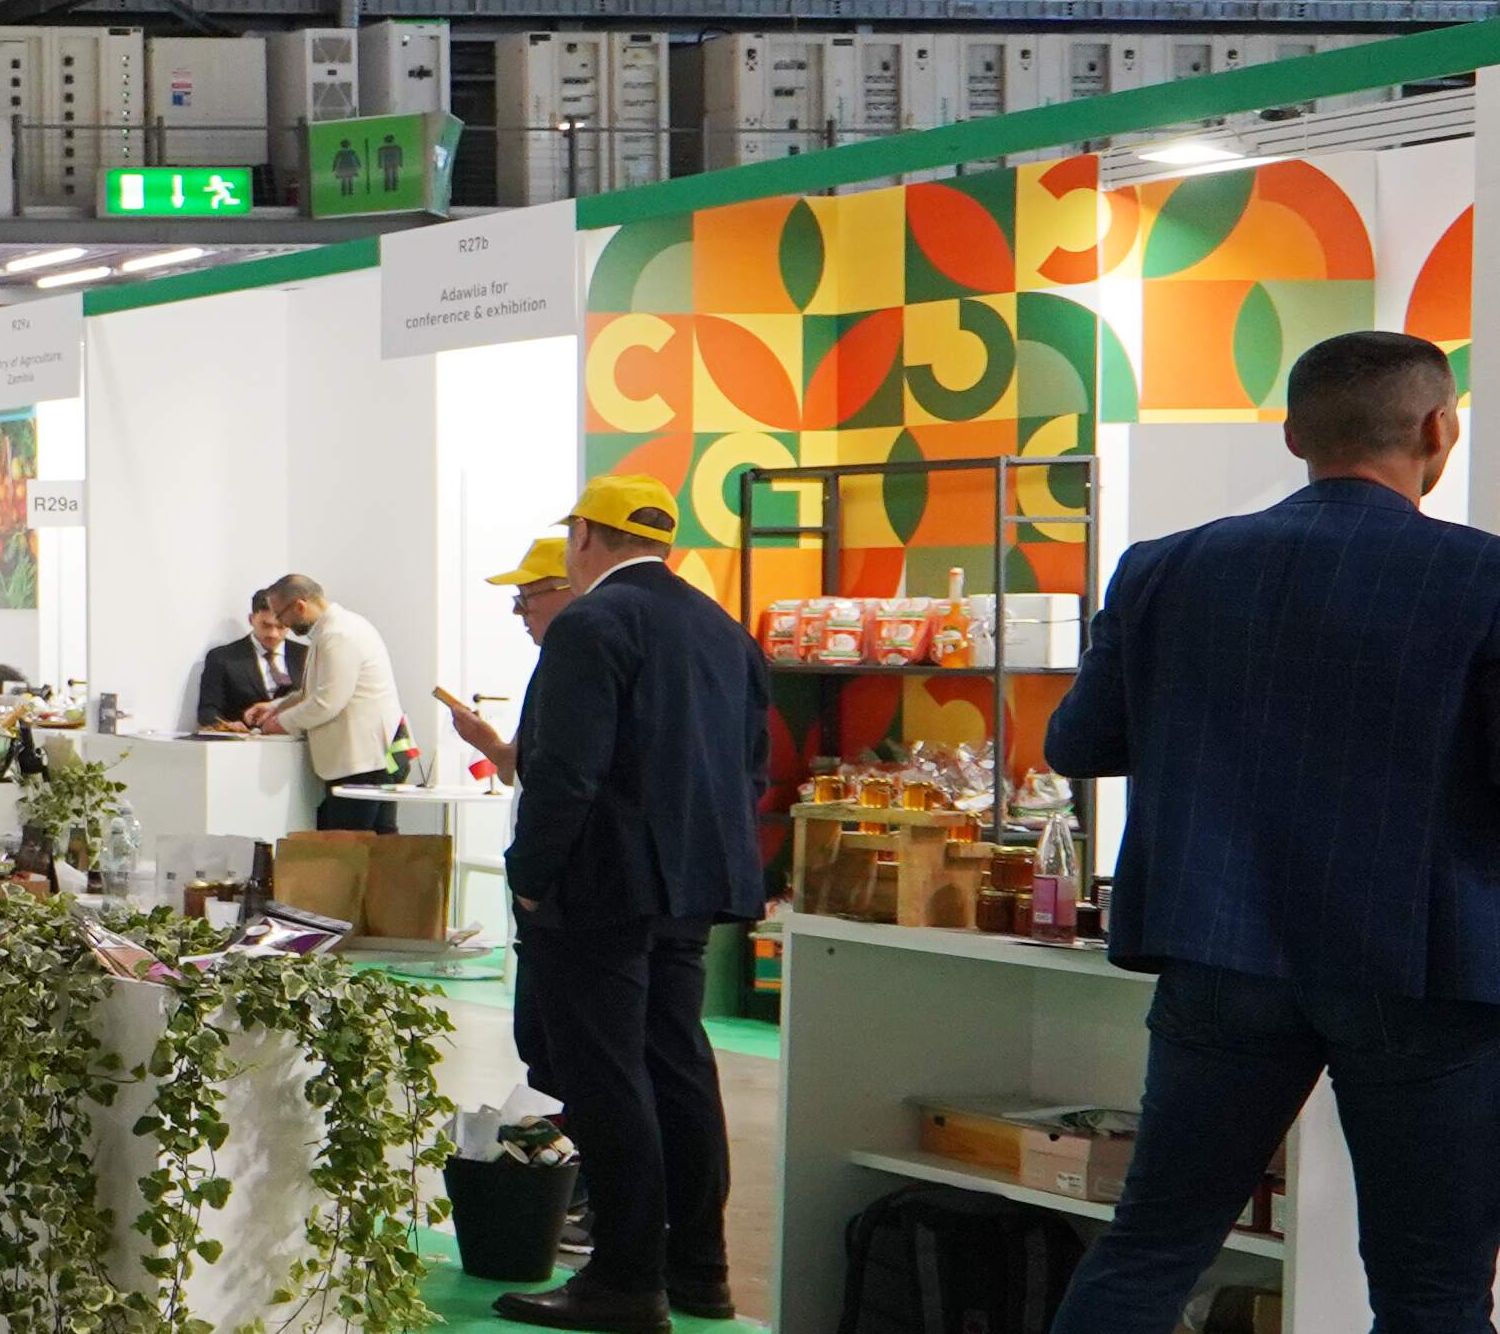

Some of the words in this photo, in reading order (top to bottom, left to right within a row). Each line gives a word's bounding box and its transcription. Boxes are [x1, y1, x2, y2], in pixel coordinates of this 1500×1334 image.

[458, 236, 489, 254] R27b
[440, 282, 488, 303] Adawlia
[491, 281, 509, 297] for
[405, 310, 470, 330] conference
[473, 306, 483, 320] &
[486, 296, 547, 318] exhibition
[33, 495, 80, 514] R29a
